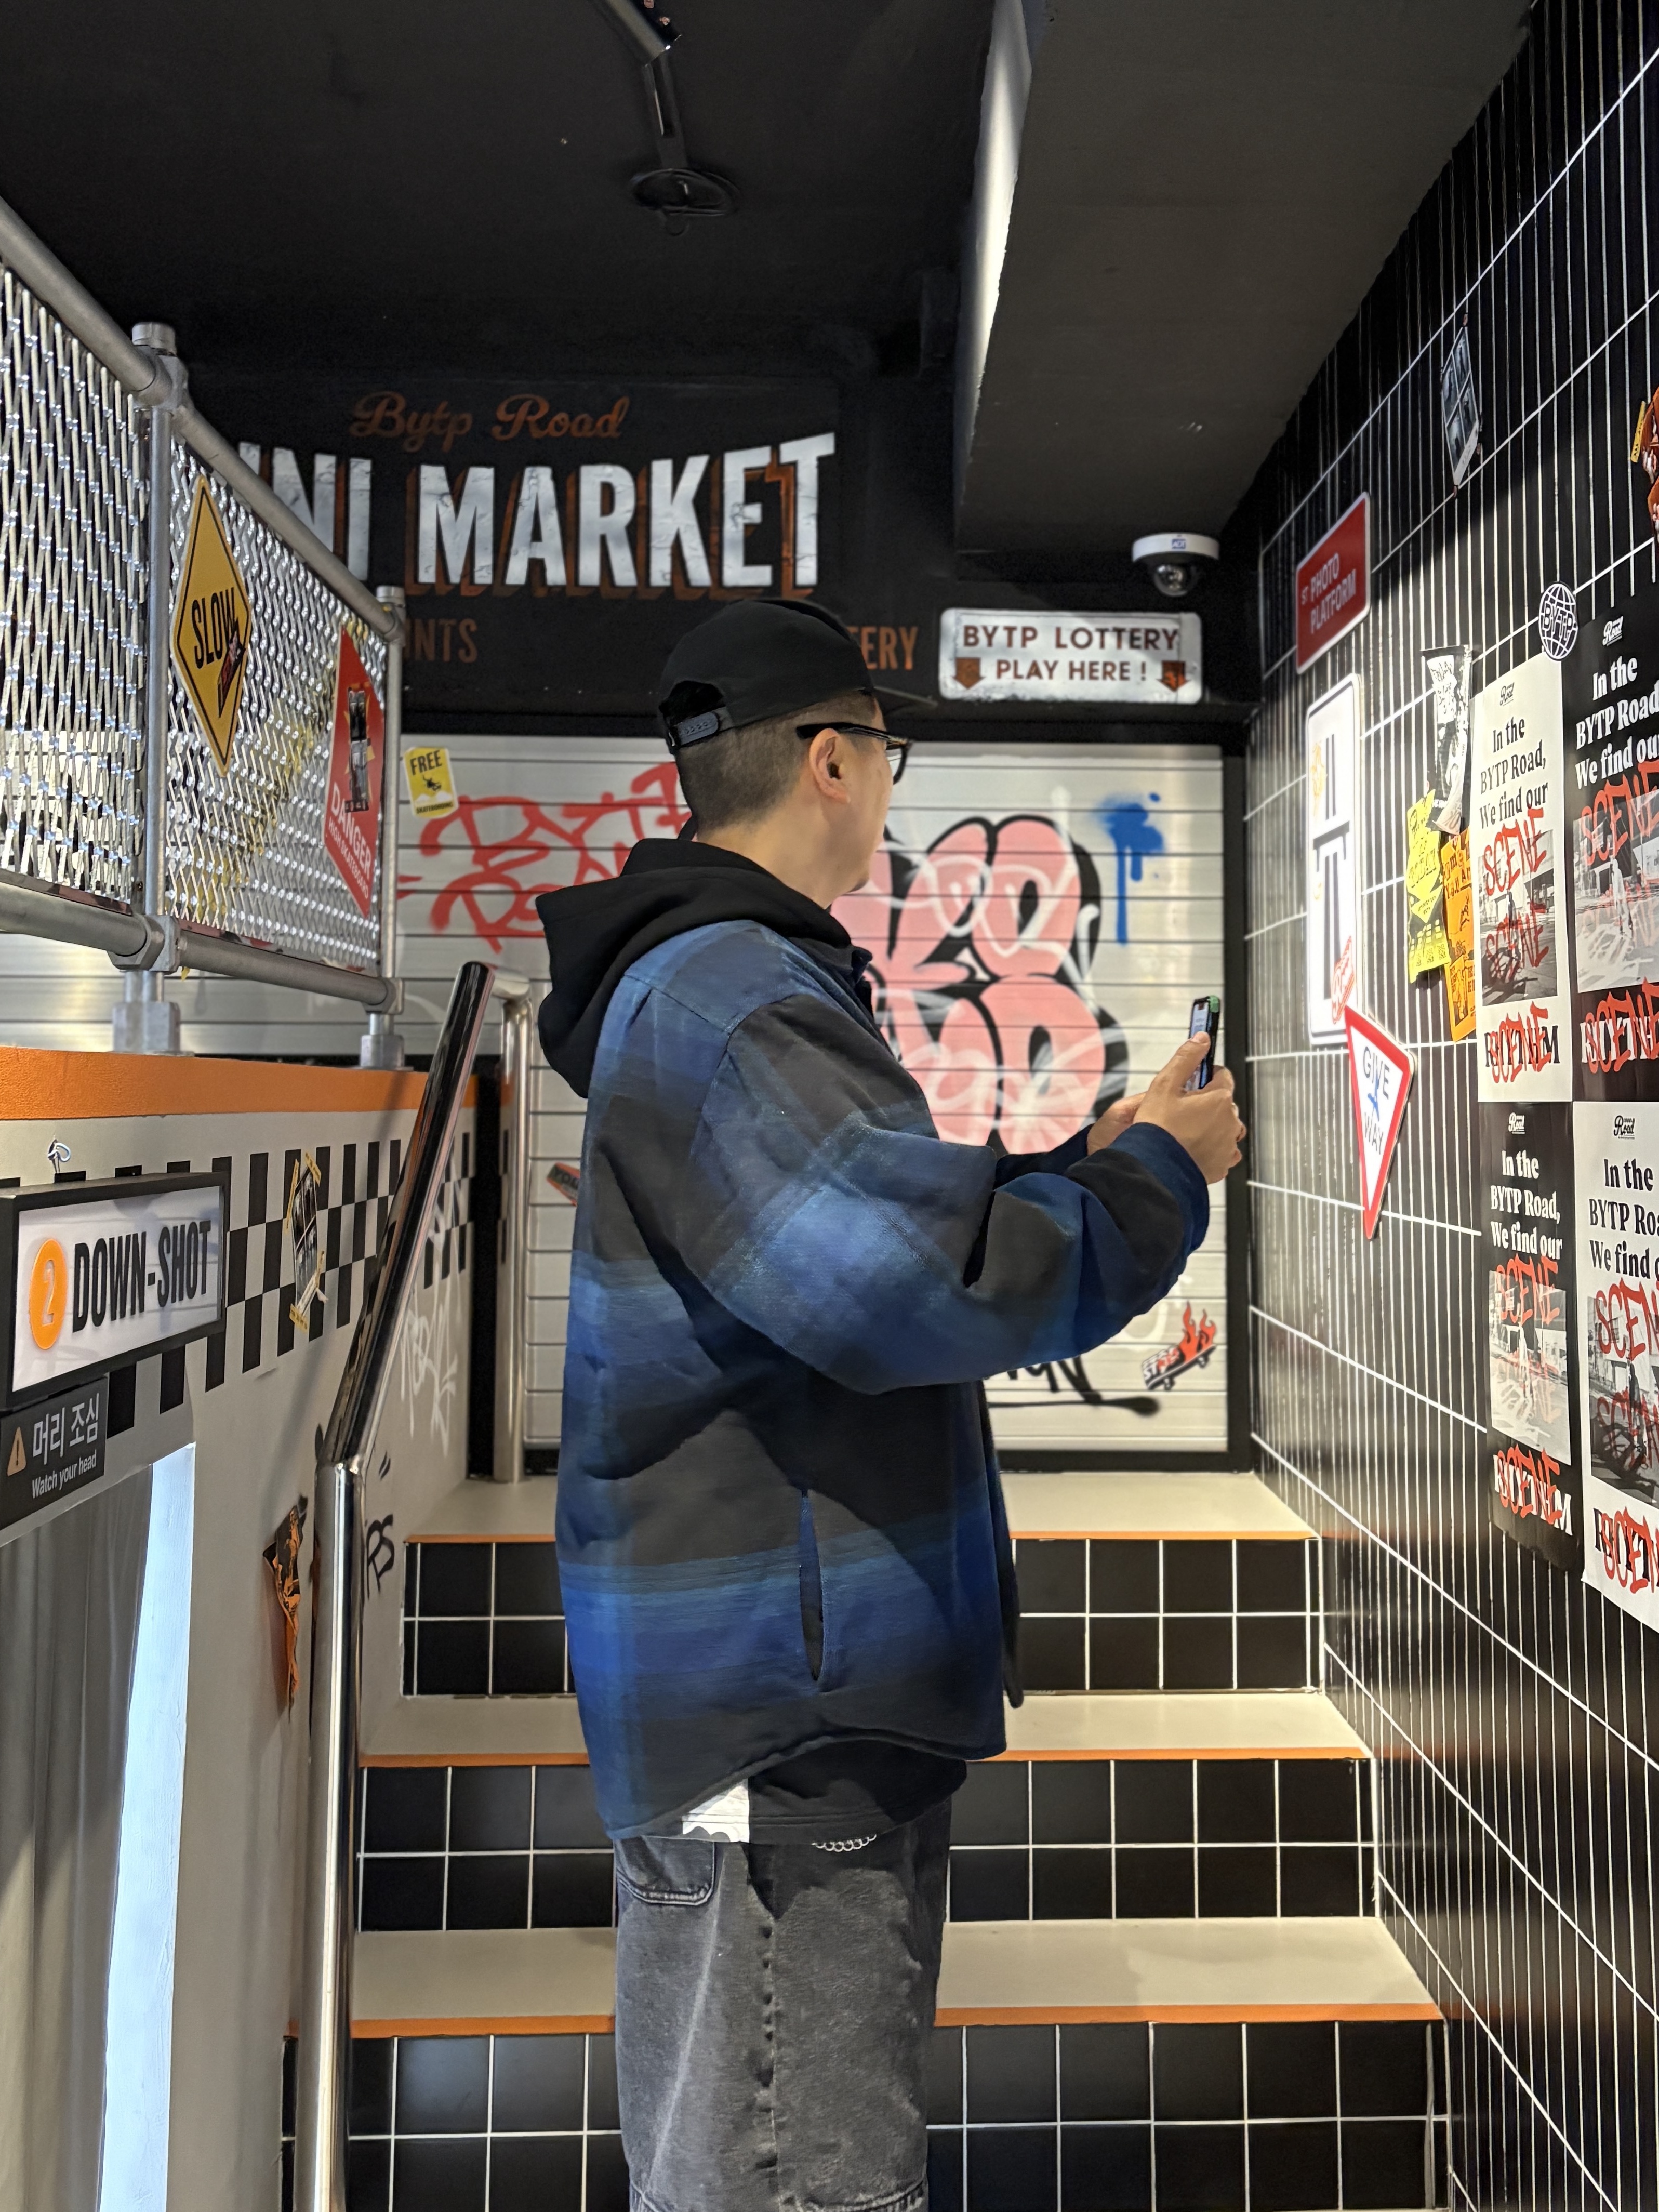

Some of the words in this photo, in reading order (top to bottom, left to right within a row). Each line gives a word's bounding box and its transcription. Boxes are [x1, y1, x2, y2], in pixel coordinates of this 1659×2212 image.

[349, 391, 472, 453] Bytp
[491, 394, 630, 441] Road
[419, 432, 835, 587] MARKET
[1311, 552, 1340, 602] PHOTO
[1311, 568, 1356, 635] PLATFORM
[192, 587, 238, 669] SLOW
[963, 625, 1038, 648] BYTP
[1055, 627, 1179, 651] LOTTERY
[996, 659, 1058, 680] PLAY
[1068, 661, 1131, 681] HERE
[1592, 672, 1608, 701] In
[1610, 656, 1638, 691] the
[1493, 729, 1503, 753] In
[1505, 716, 1525, 745] the
[1576, 705, 1615, 750] BYTP
[410, 750, 442, 776] FREE
[1481, 759, 1508, 795] BYTP
[1511, 739, 1546, 780] Road,
[1575, 758, 1598, 790] We
[1600, 735, 1634, 779] find
[1636, 733, 1659, 764] ou
[1479, 803, 1496, 829] We
[1499, 786, 1522, 822] find
[1525, 782, 1549, 810] our
[331, 782, 371, 880] DANGER
[328, 821, 341, 847] HIGH
[341, 839, 369, 900] SKATEBOARD
[1362, 1045, 1391, 1101] GIVE
[1364, 1111, 1384, 1155] WAY
[1502, 1150, 1515, 1177] In
[1516, 1149, 1539, 1180] the
[1604, 1158, 1621, 1188] In
[1623, 1158, 1654, 1191] the
[1490, 1185, 1522, 1214] BYTP
[1524, 1191, 1561, 1225] Road,
[1589, 1198, 1630, 1231] BYTP
[1634, 1204, 1659, 1236] Ro
[1490, 1221, 1509, 1249] We
[1511, 1221, 1538, 1255] find
[1540, 1235, 1563, 1261] our
[1589, 1239, 1611, 1271] We
[1615, 1240, 1651, 1279] find
[42, 1259, 55, 1327] 2
[72, 1220, 211, 1333] DOWN-SHOT
[1596, 1277, 1659, 1362] SCEN
[33, 1407, 65, 1465] 머리
[69, 1393, 99, 1447] 조심
[32, 1470, 58, 1499] Watch
[59, 1463, 77, 1490] your
[79, 1449, 97, 1476] head
